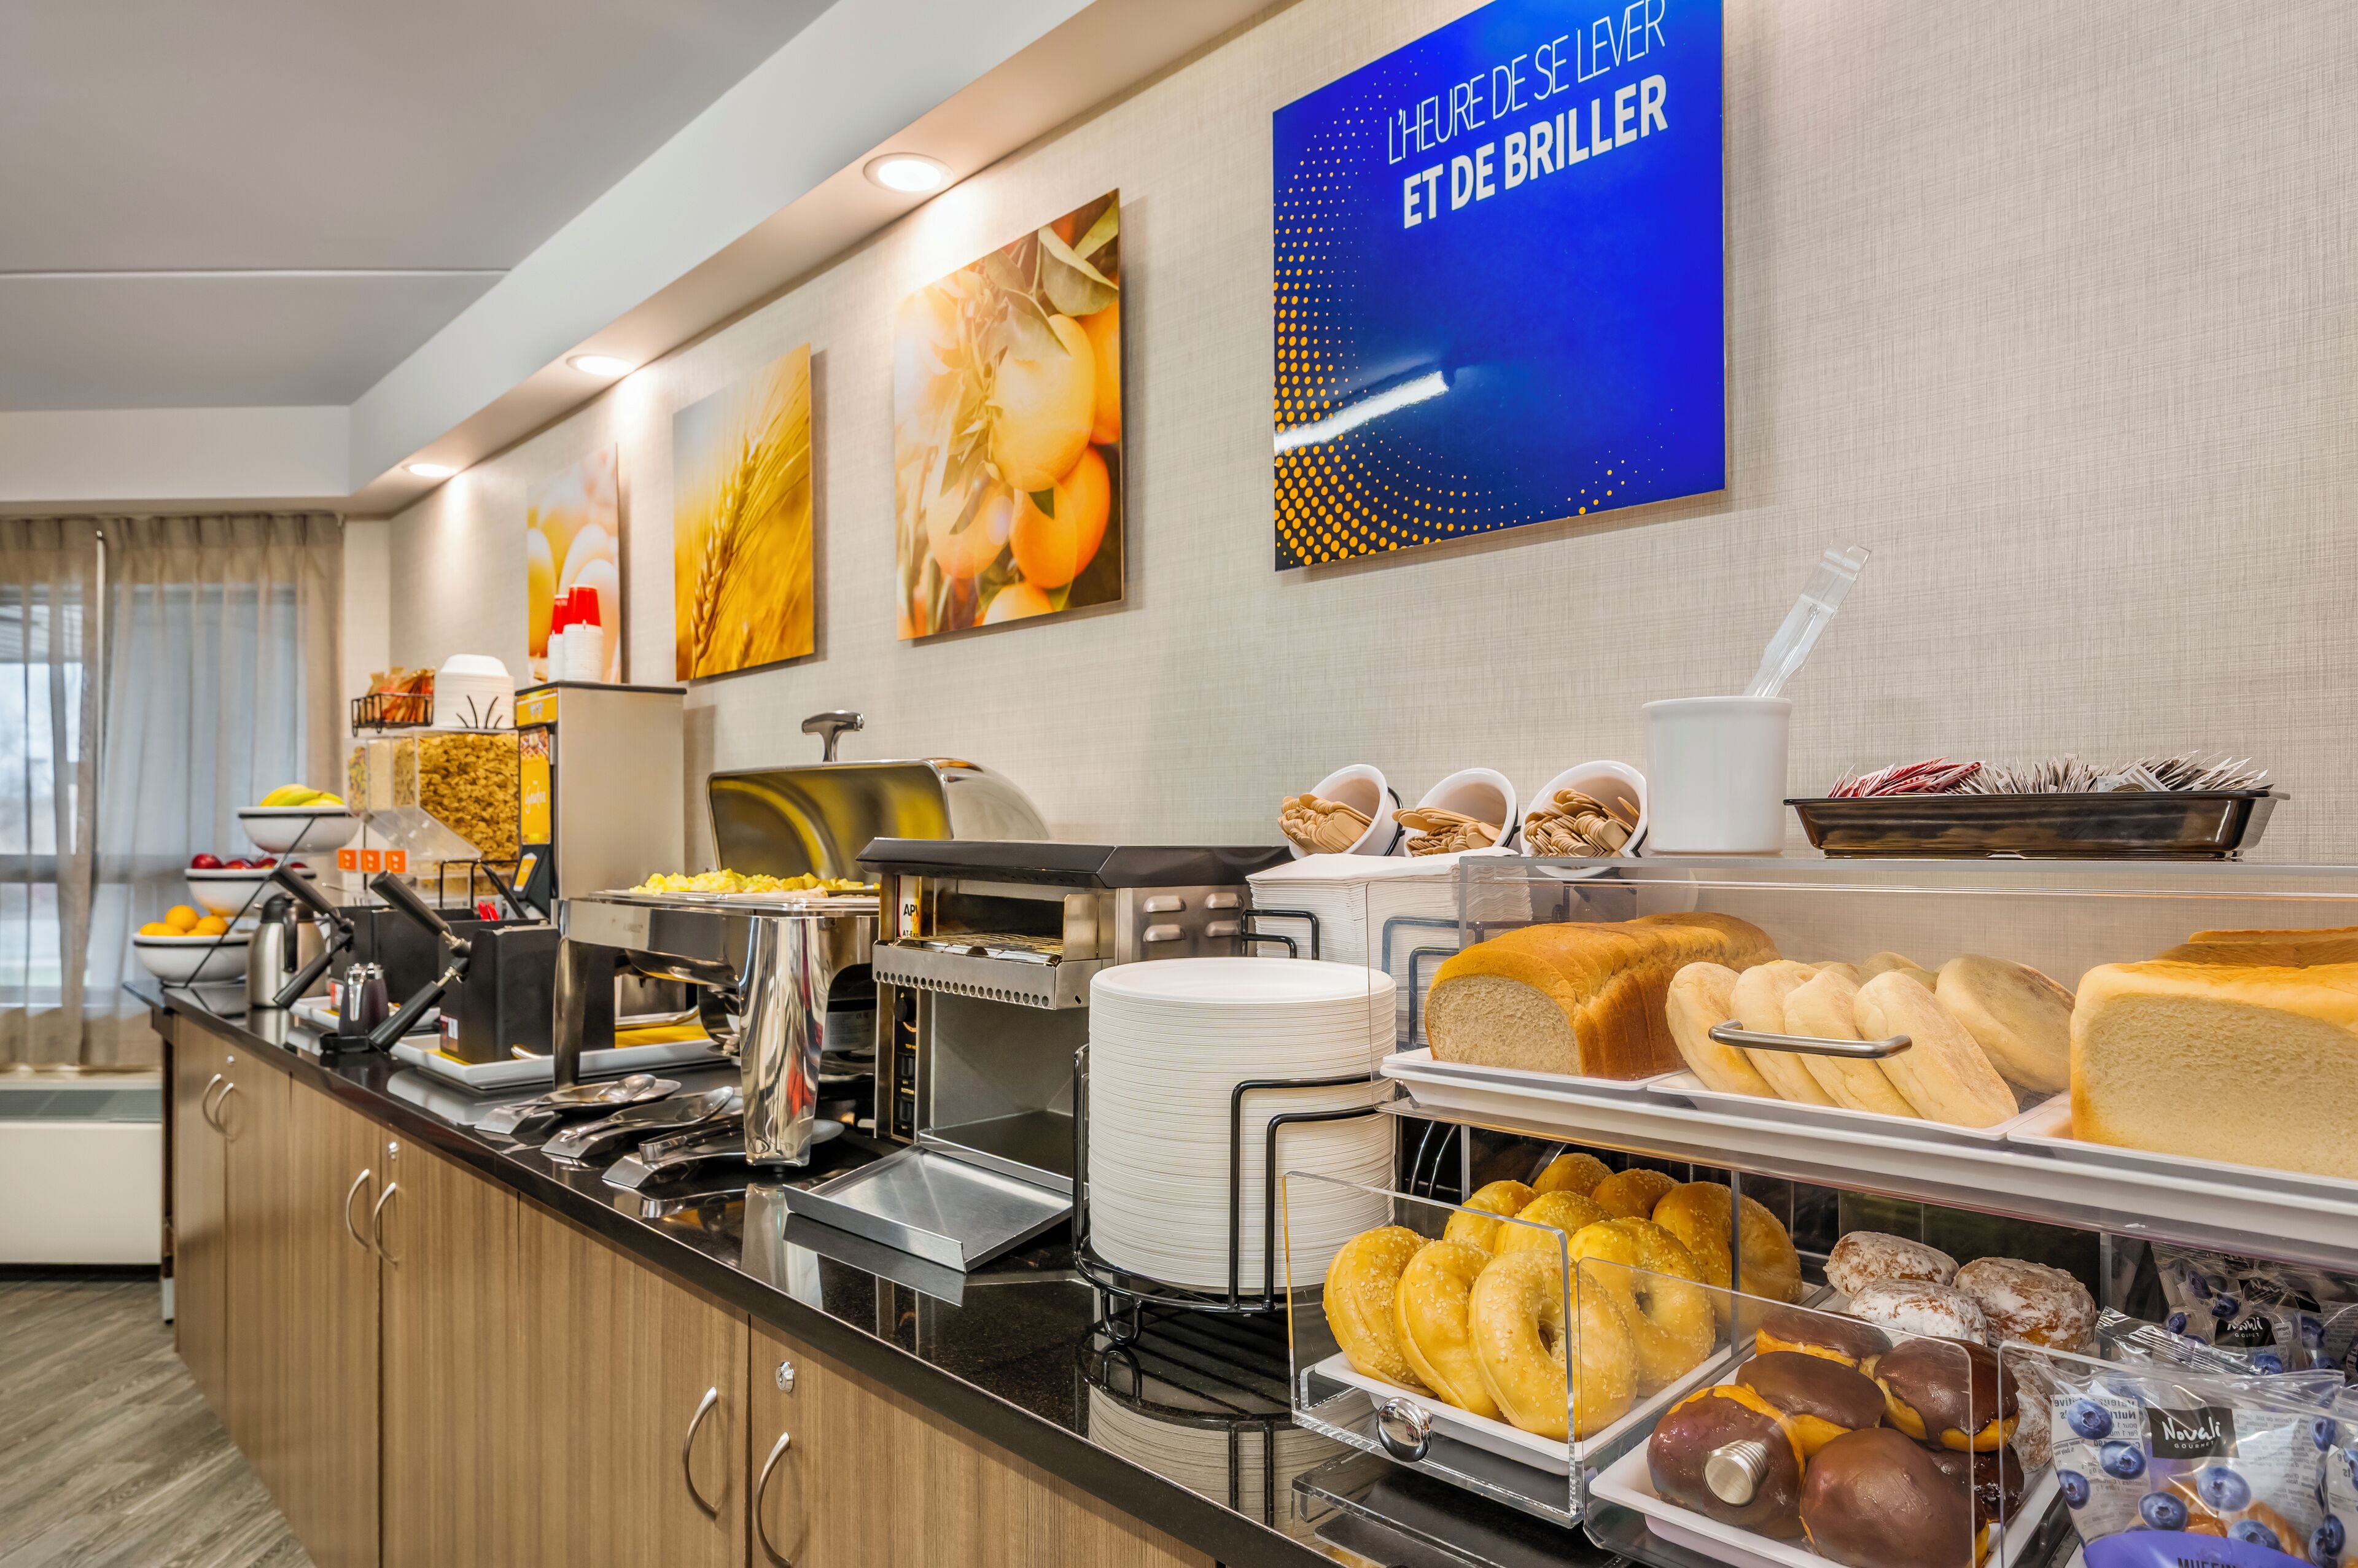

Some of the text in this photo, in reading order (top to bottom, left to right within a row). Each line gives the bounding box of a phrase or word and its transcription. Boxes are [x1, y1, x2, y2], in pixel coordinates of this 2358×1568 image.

[1389, 0, 1666, 165] L'HEURE DE SE LEVER
[1404, 74, 1668, 230] ET DE BRILLER
[2162, 1416, 2220, 1441] Novali
